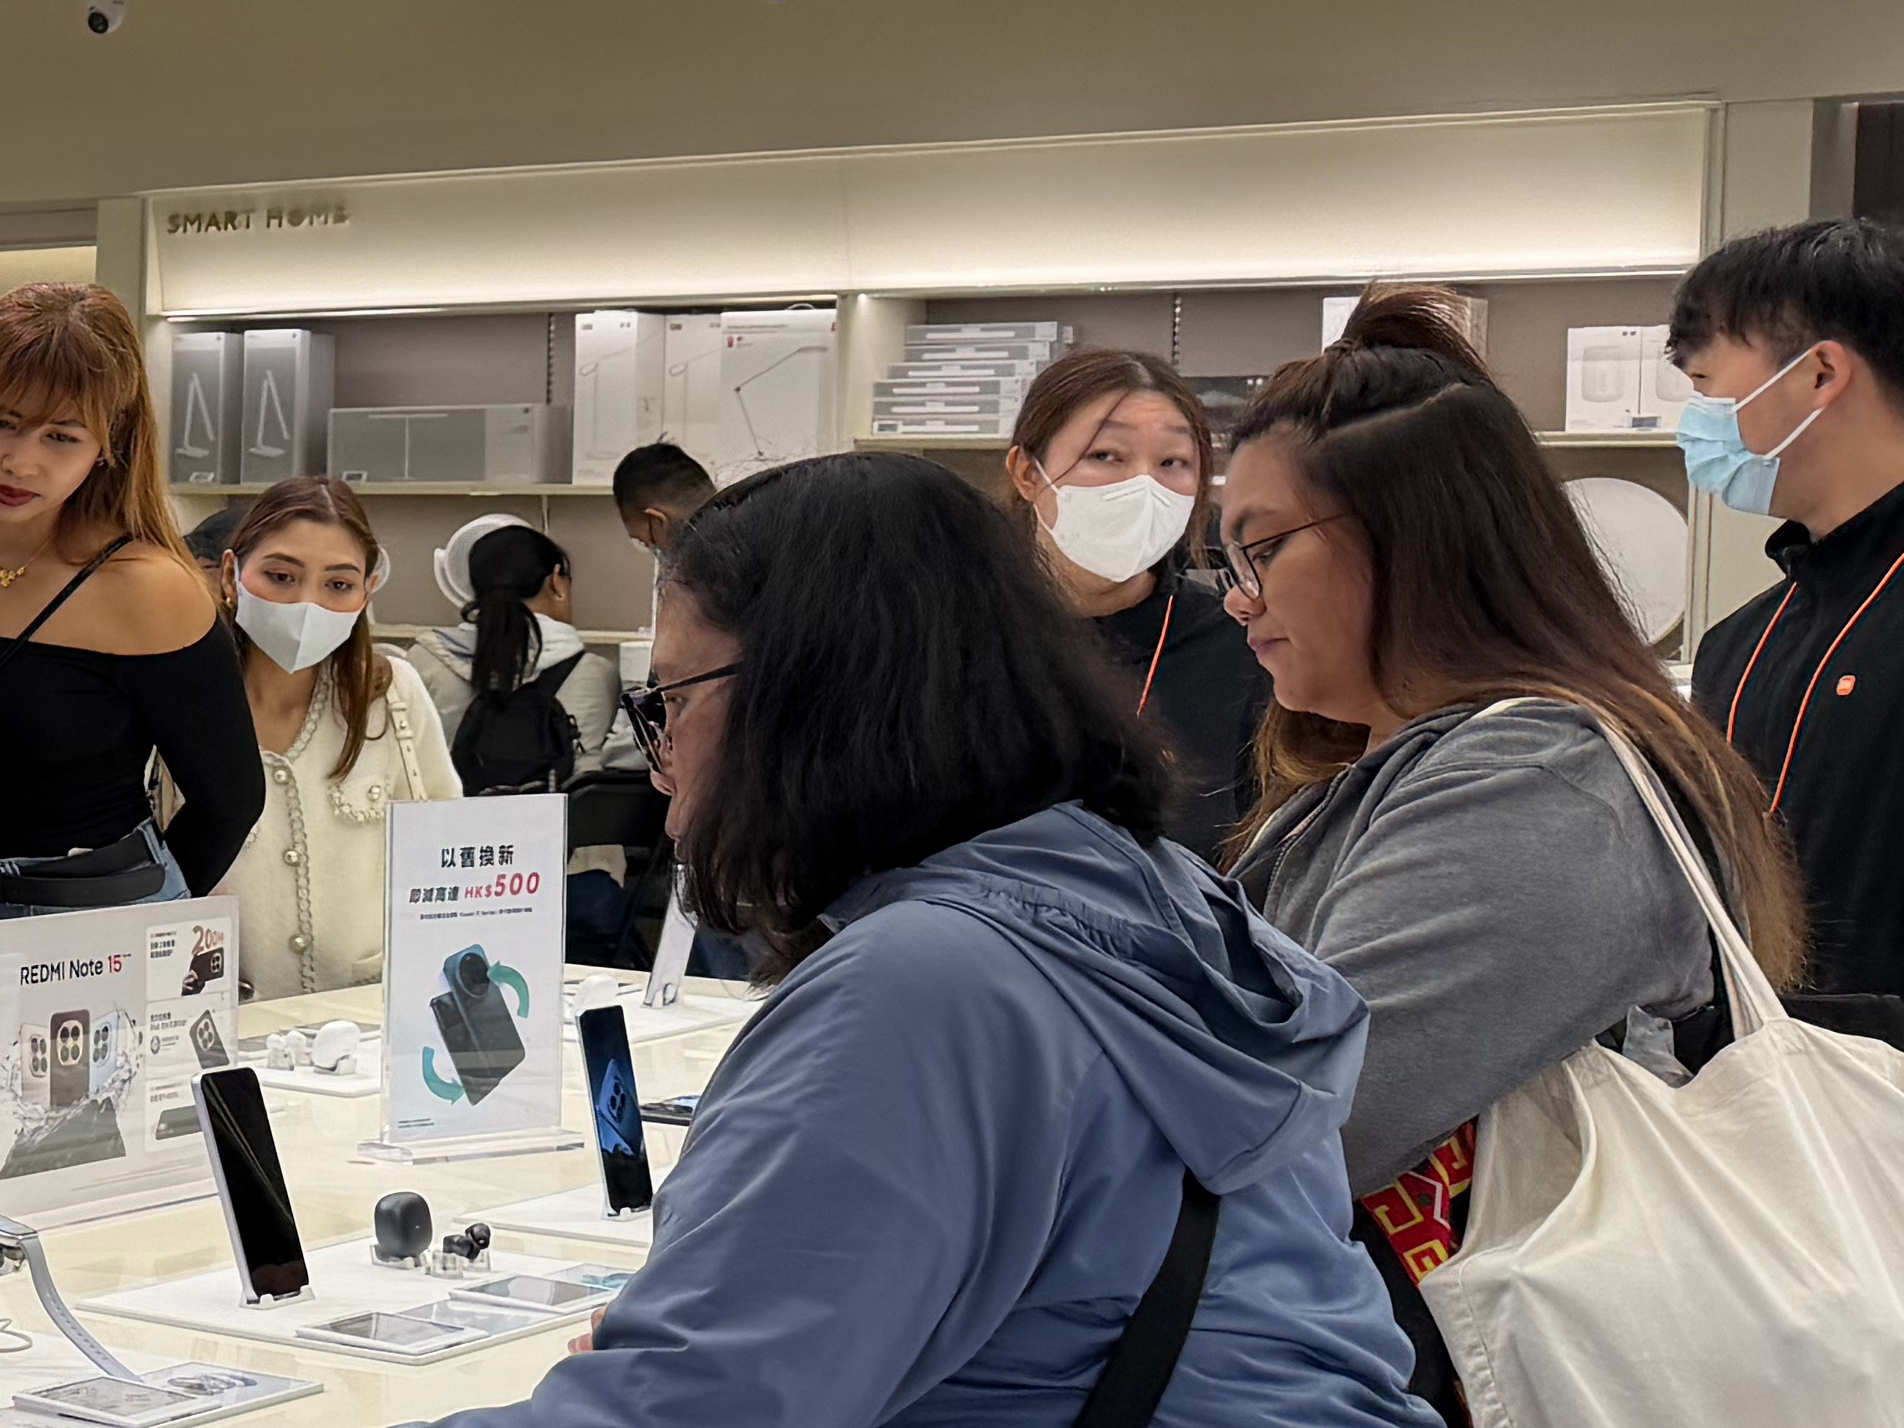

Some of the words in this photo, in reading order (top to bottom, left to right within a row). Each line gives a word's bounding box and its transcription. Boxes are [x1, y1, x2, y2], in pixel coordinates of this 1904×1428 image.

[166, 210, 256, 234] SMART
[441, 844, 515, 868] 以舊換新
[464, 871, 541, 899] HK$500
[20, 961, 65, 985] REDMI
[69, 958, 103, 979] Note
[107, 953, 123, 973] 15
